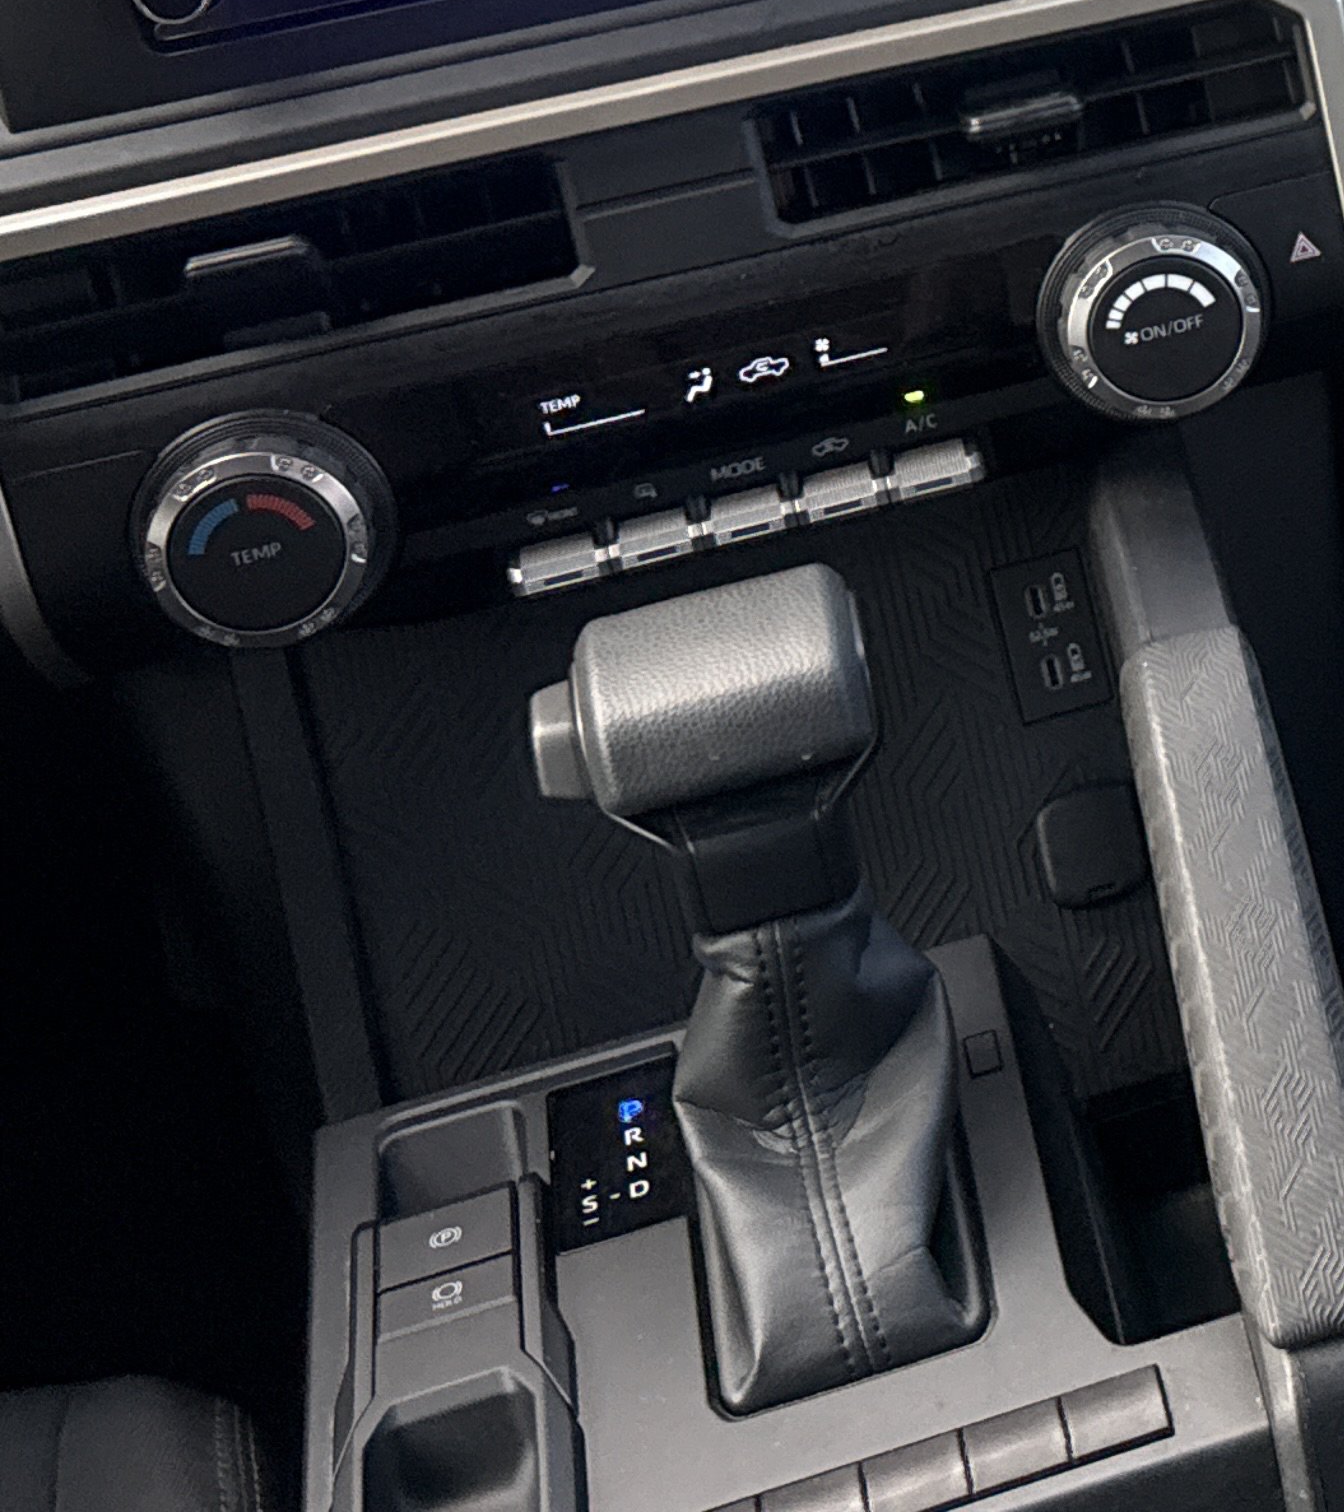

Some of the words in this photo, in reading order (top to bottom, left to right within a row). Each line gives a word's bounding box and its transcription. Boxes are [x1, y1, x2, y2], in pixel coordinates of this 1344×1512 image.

[1140, 314, 1205, 342] ON/OFF
[539, 394, 581, 416] TEMP
[904, 413, 938, 434] A/C
[711, 456, 766, 482] MODE
[230, 541, 283, 567] TEMP
[618, 1098, 644, 1124] P
[624, 1126, 645, 1147] R
[626, 1151, 648, 1173] N
[581, 1194, 599, 1214] S
[629, 1180, 650, 1199] D
